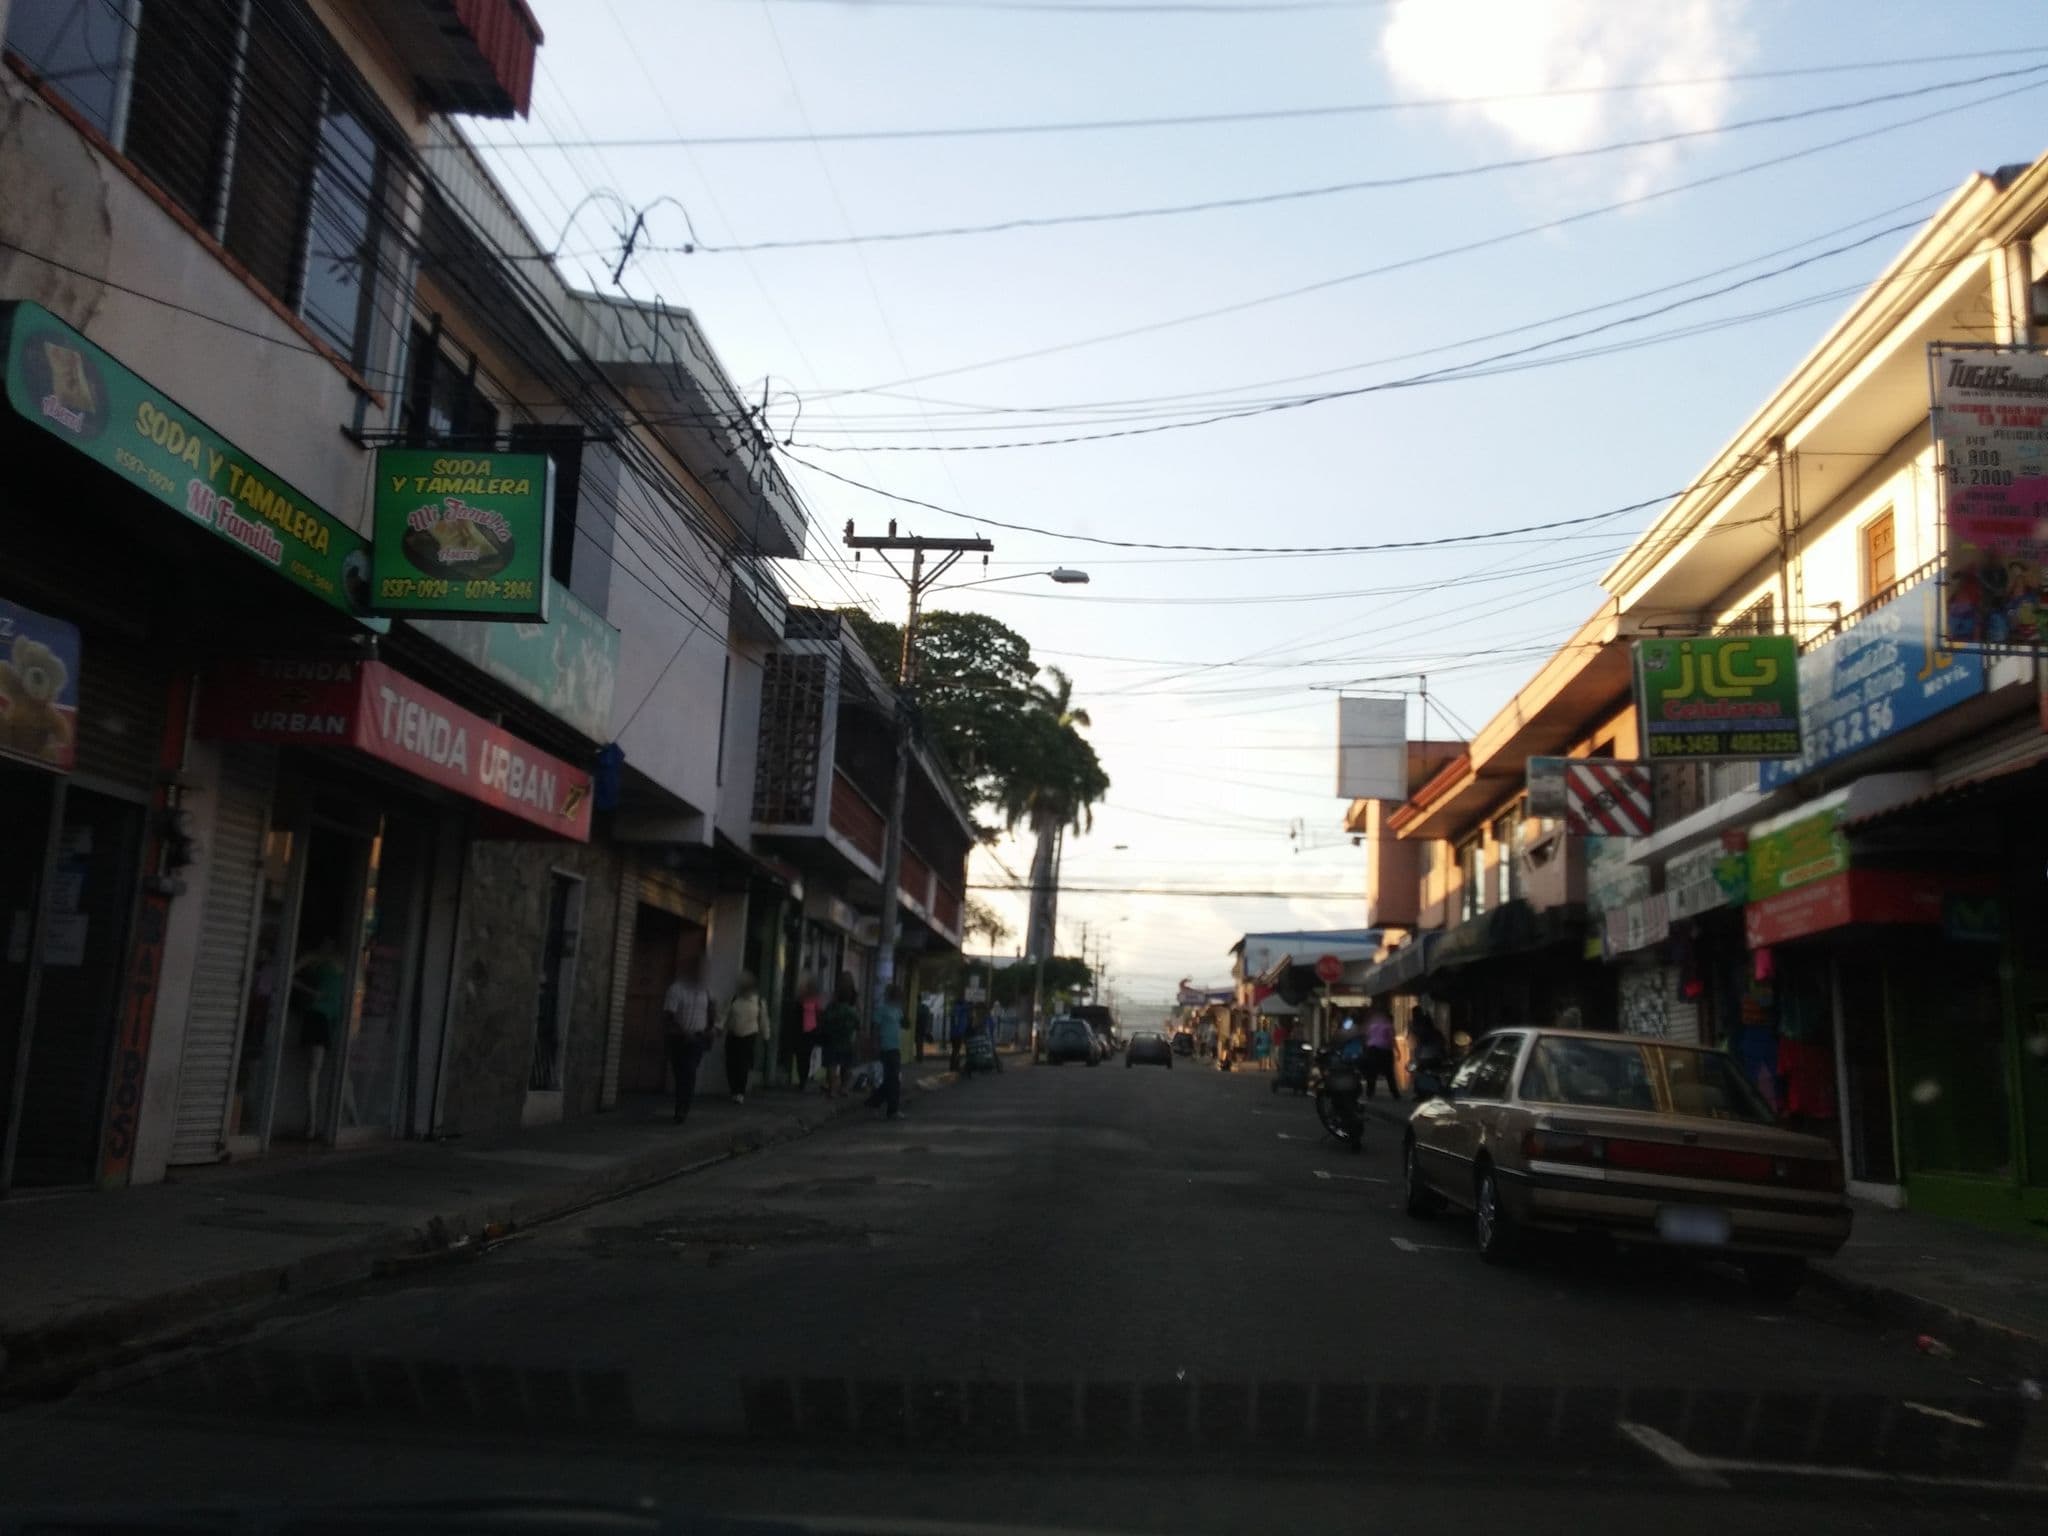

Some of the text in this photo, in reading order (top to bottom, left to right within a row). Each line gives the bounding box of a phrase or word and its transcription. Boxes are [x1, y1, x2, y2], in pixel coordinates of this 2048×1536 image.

[136, 401, 200, 470] SODA
[207, 448, 225, 481] Y
[229, 463, 330, 555] TAMALERA
[432, 459, 492, 476] SODA
[1971, 470, 2013, 487] 2000
[392, 476, 531, 495] Y TAMALERA
[187, 478, 284, 565] Mi Familia
[407, 497, 513, 543] Mi Familia
[381, 578, 449, 598] 8587-0924
[250, 657, 352, 682] TIENDA
[251, 711, 346, 736] URBAN
[379, 685, 469, 776] TIENDA
[479, 739, 557, 812] URBAN
